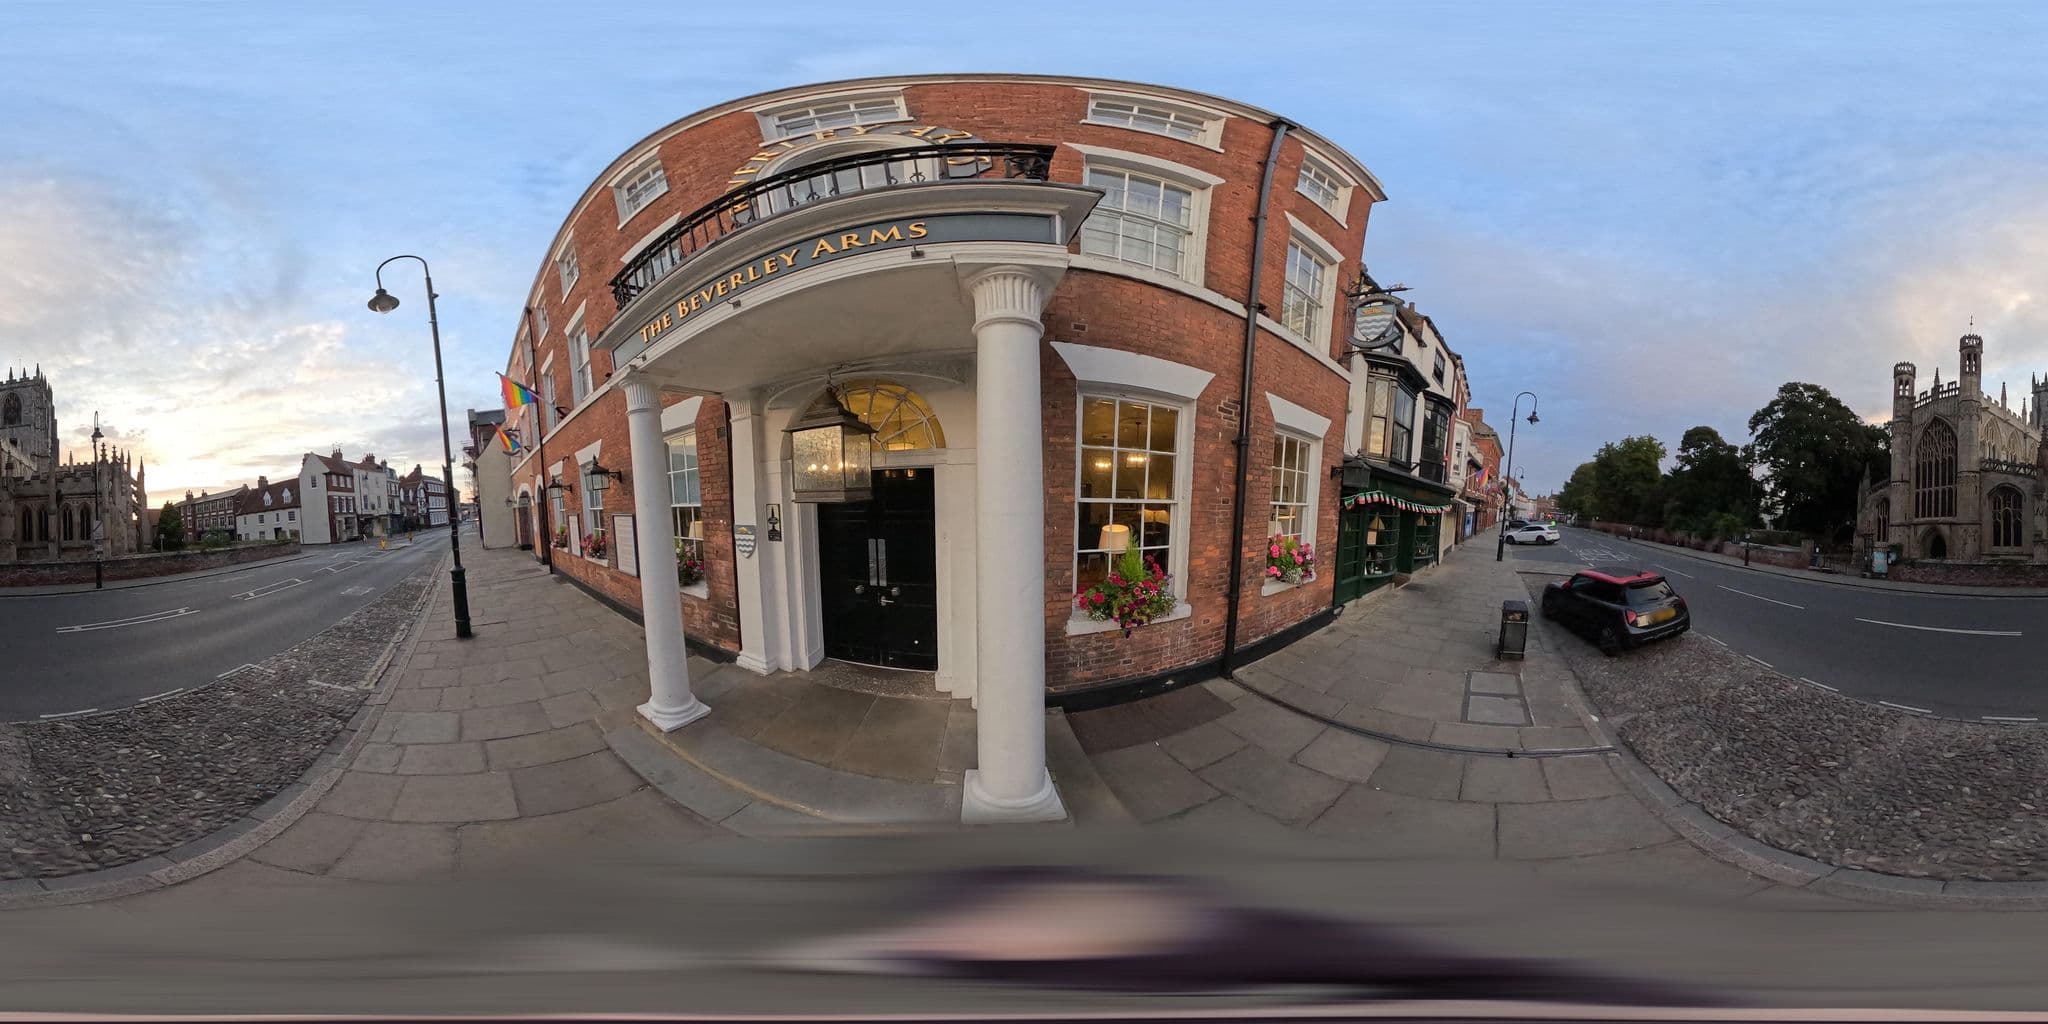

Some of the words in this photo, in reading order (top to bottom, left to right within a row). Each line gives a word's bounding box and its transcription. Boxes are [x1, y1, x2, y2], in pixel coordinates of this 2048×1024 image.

[640, 312, 673, 344] THE
[677, 248, 800, 319] BEVERLEY
[810, 221, 929, 260] ARMS
